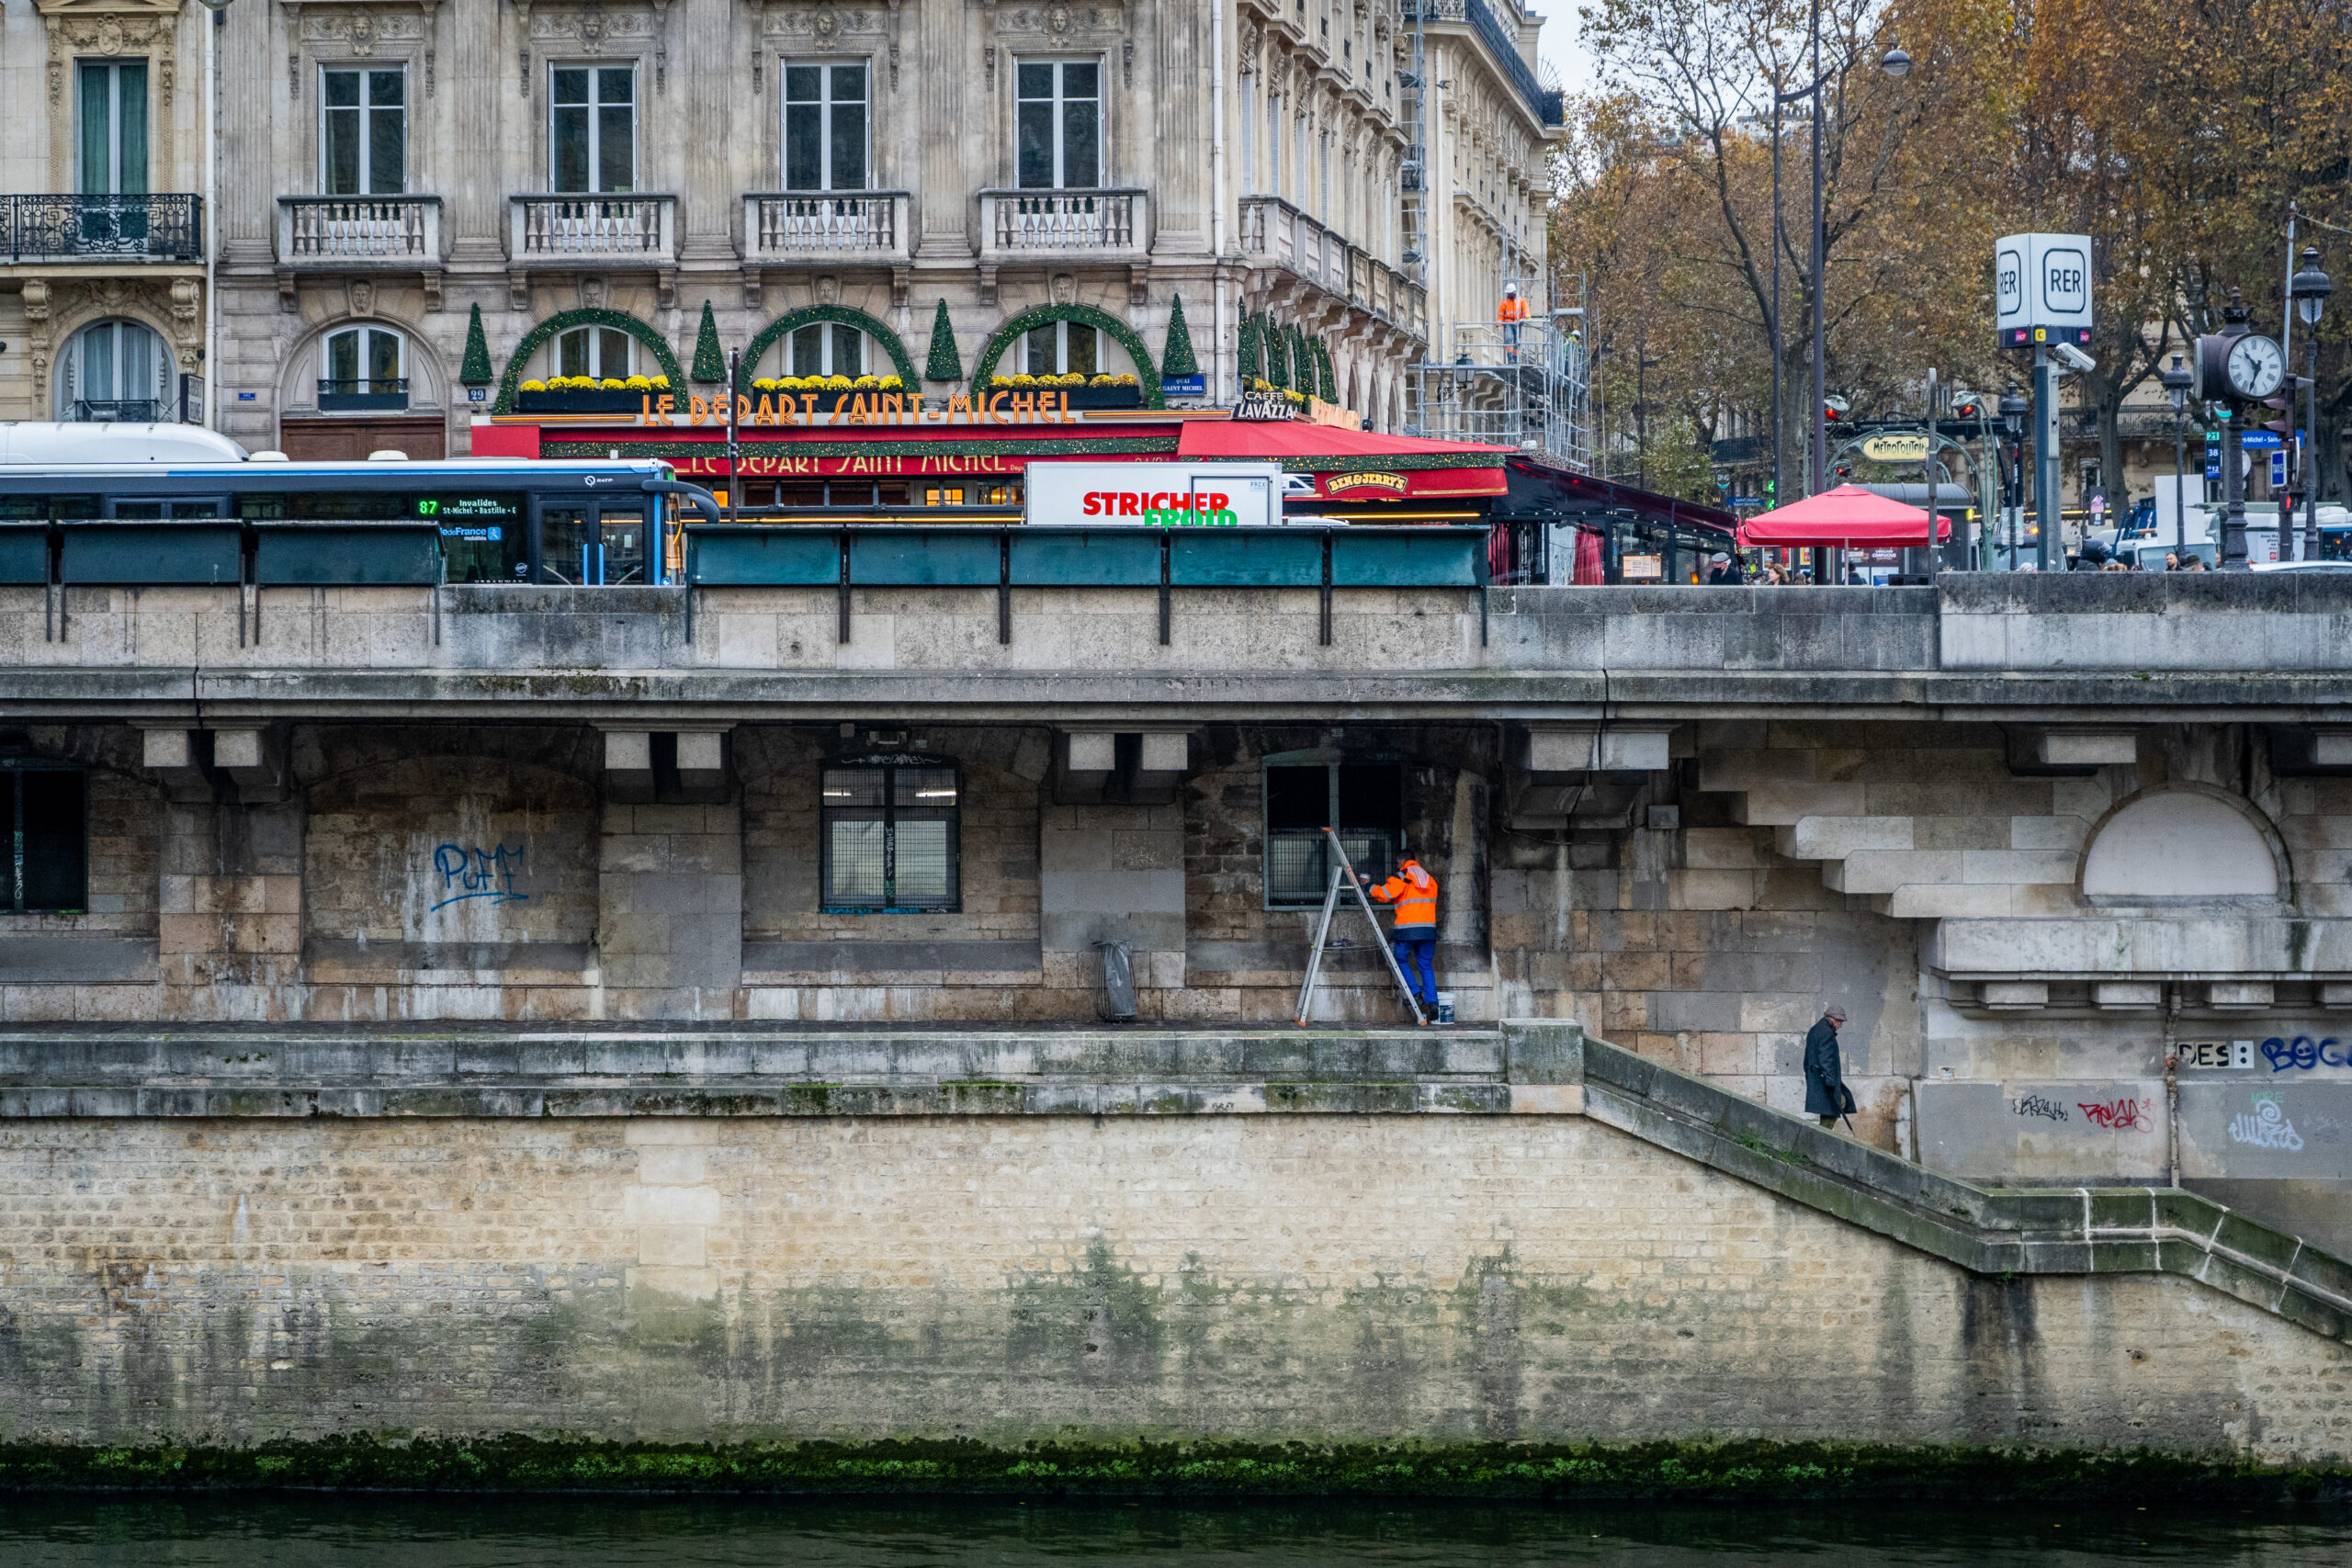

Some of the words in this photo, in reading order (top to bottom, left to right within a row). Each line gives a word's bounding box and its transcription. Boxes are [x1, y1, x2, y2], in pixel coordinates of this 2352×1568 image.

[2000, 270, 2017, 295] RER
[2051, 268, 2081, 293] RER
[2038, 331, 2043, 339] C
[470, 389, 484, 400] 29
[643, 394, 674, 426] LE
[1238, 401, 1295, 420] LAVAZZA
[2208, 448, 2219, 457] 38
[419, 501, 438, 514] 87
[459, 499, 497, 507] Invalides
[1083, 491, 1229, 516] STRICHER
